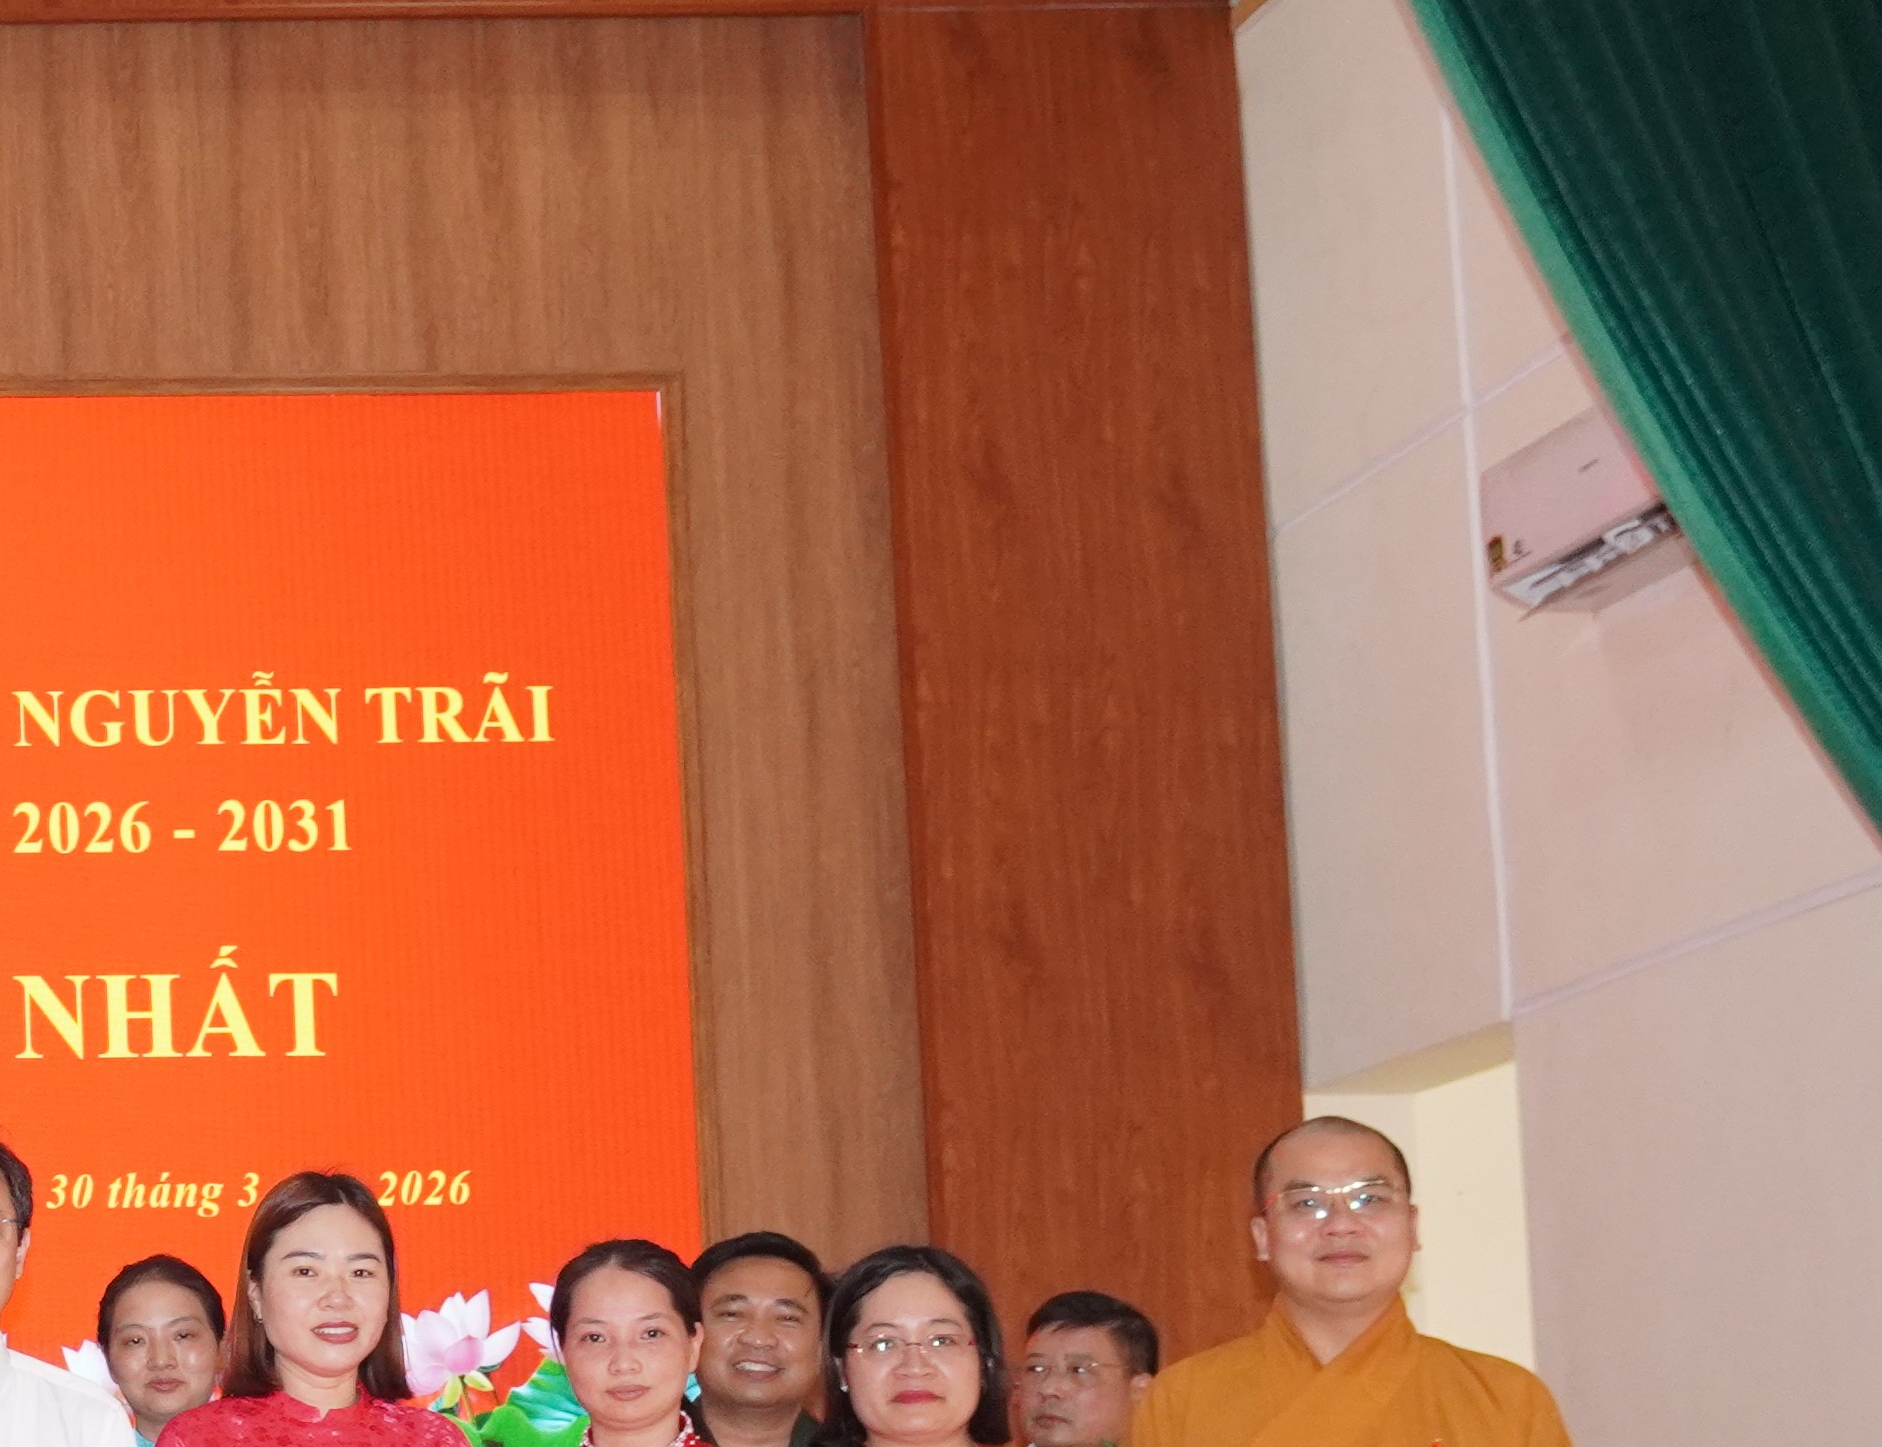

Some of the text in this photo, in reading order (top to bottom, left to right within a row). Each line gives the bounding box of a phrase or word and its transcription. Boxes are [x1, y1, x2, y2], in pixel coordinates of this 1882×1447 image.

[12, 670, 341, 748] NGUYỄN
[364, 671, 554, 744] TRÃI
[12, 800, 152, 854] 2026
[173, 829, 196, 839] -
[217, 799, 351, 853] 2031
[12, 945, 338, 1060] NHẤT
[45, 1171, 260, 1218] 30 tháng 3
[377, 1169, 471, 1207] 2026
